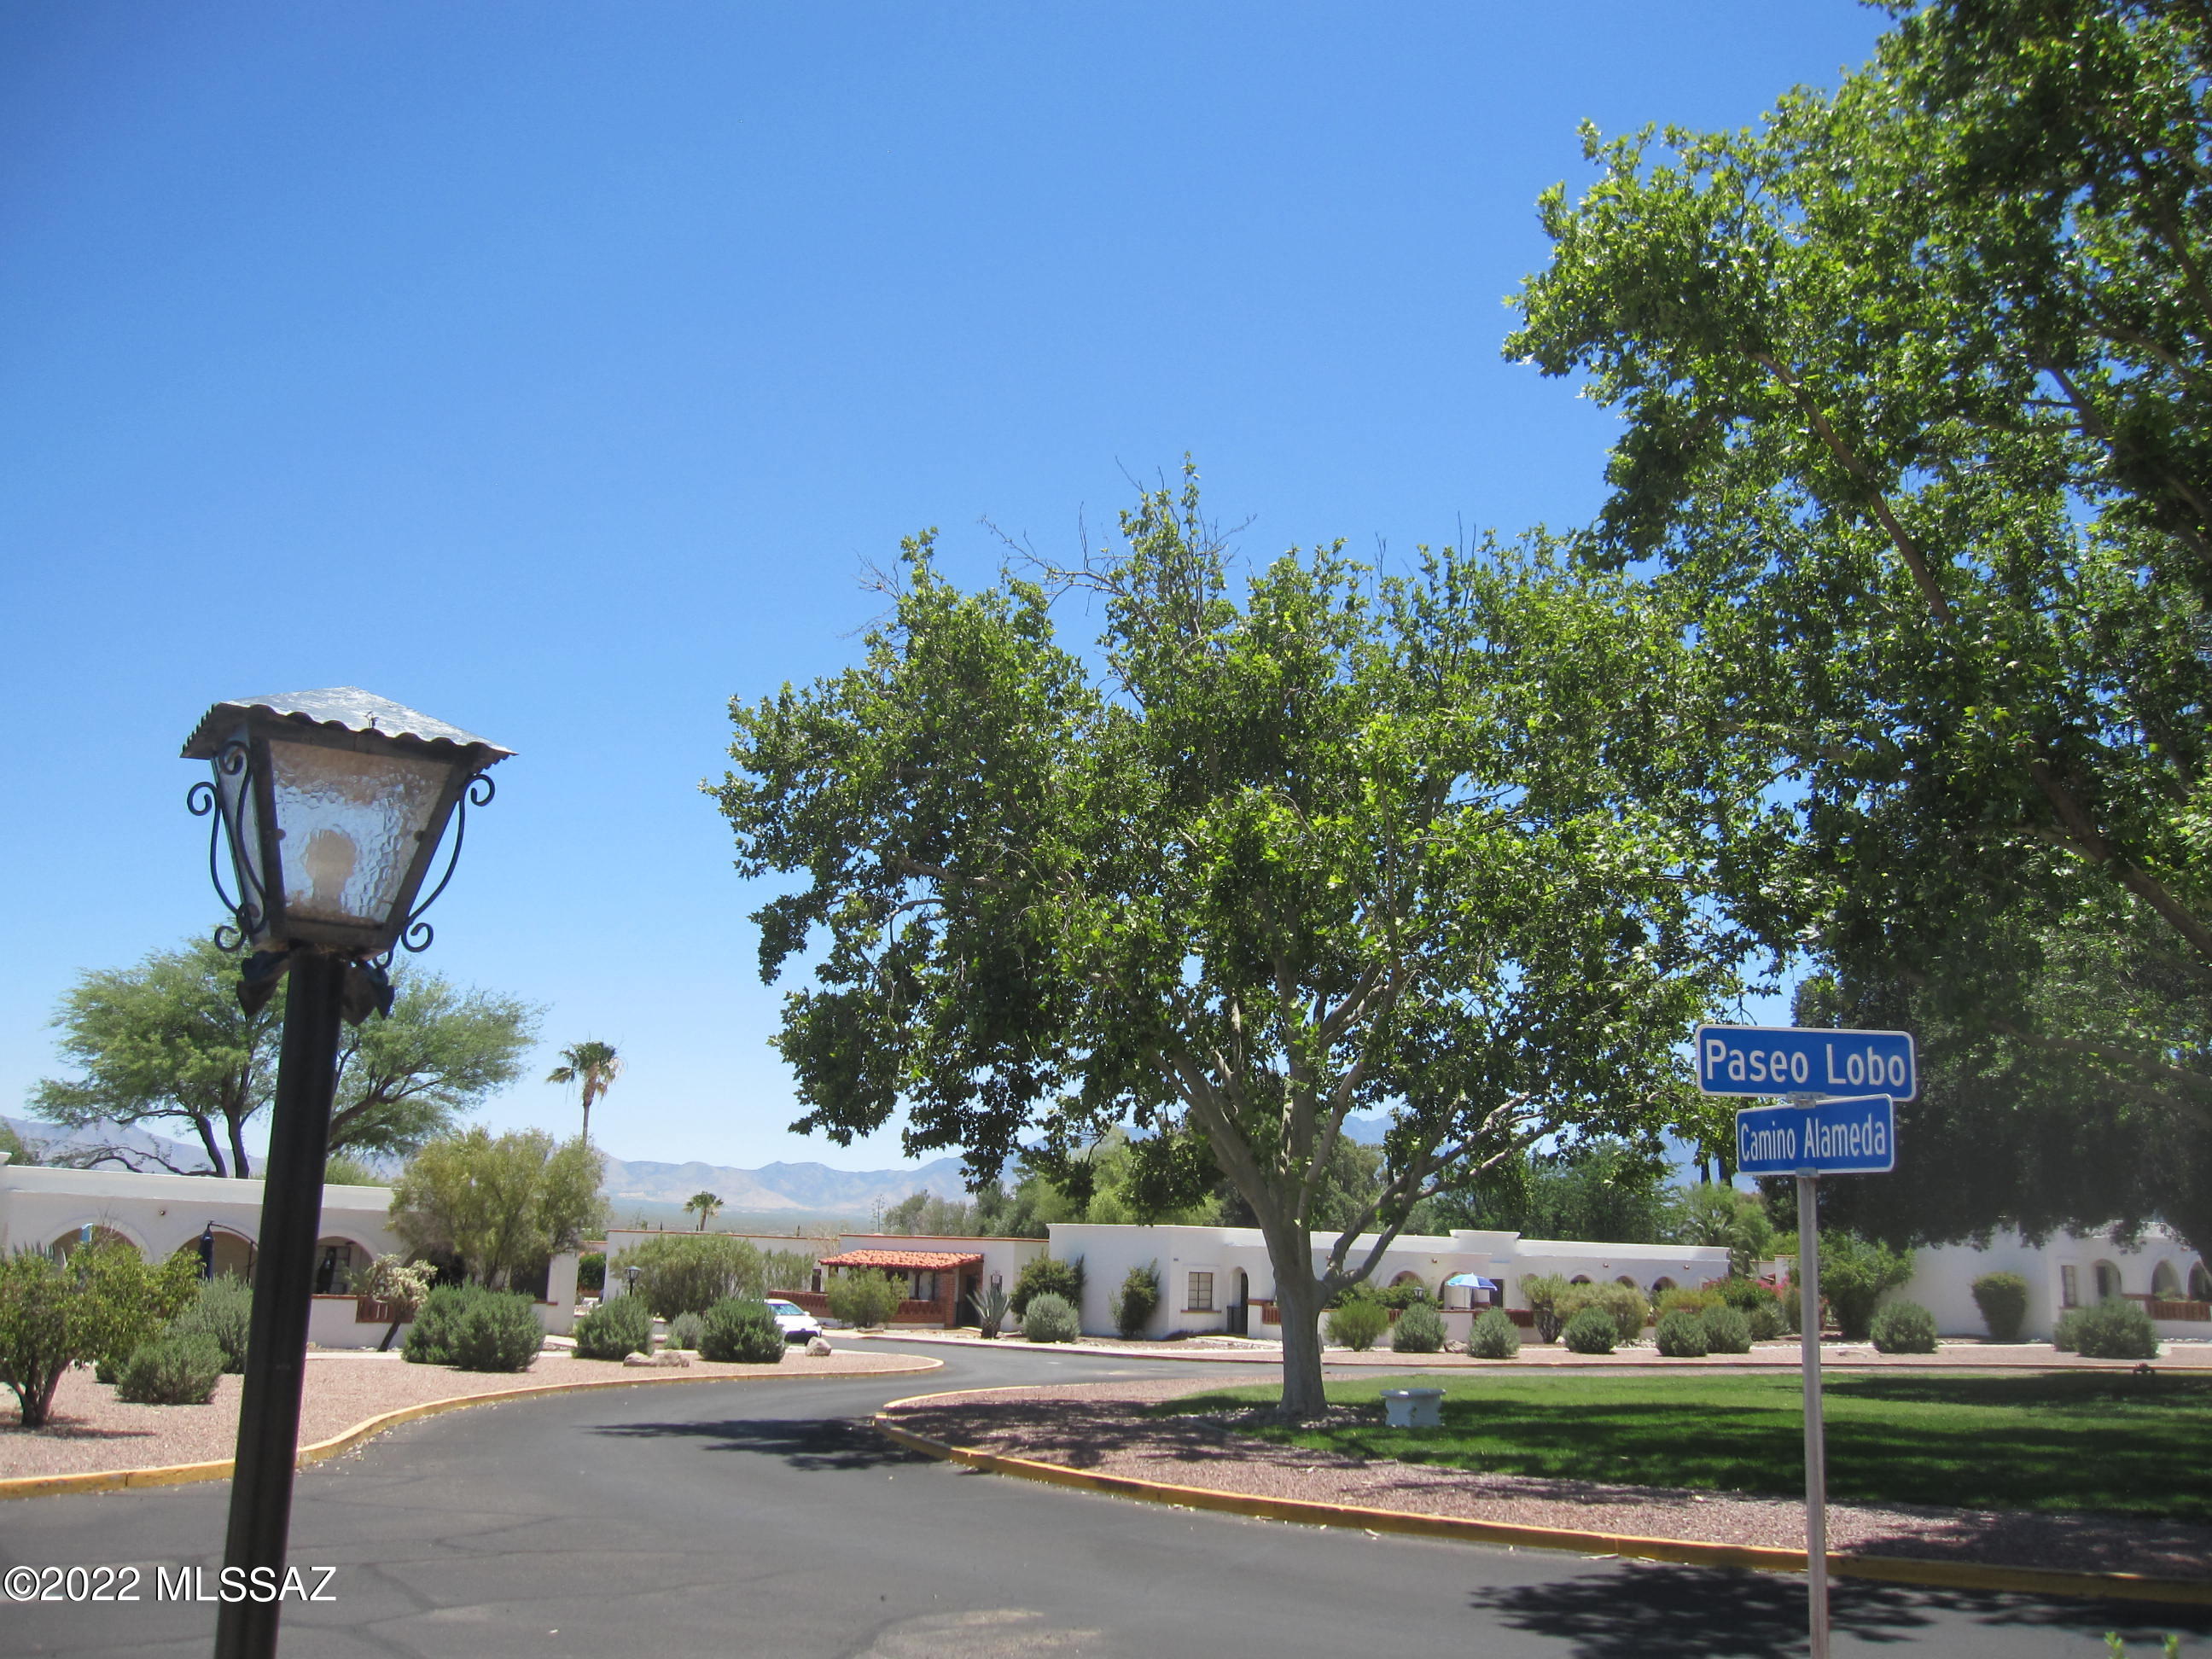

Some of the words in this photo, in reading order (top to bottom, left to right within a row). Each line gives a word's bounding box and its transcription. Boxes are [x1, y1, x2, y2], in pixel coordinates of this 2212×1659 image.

[1706, 1039, 1808, 1084] Paseo
[1826, 1043, 1906, 1086] Lobo
[1740, 1121, 1796, 1162] Camino
[1804, 1113, 1886, 1159] Alameda
